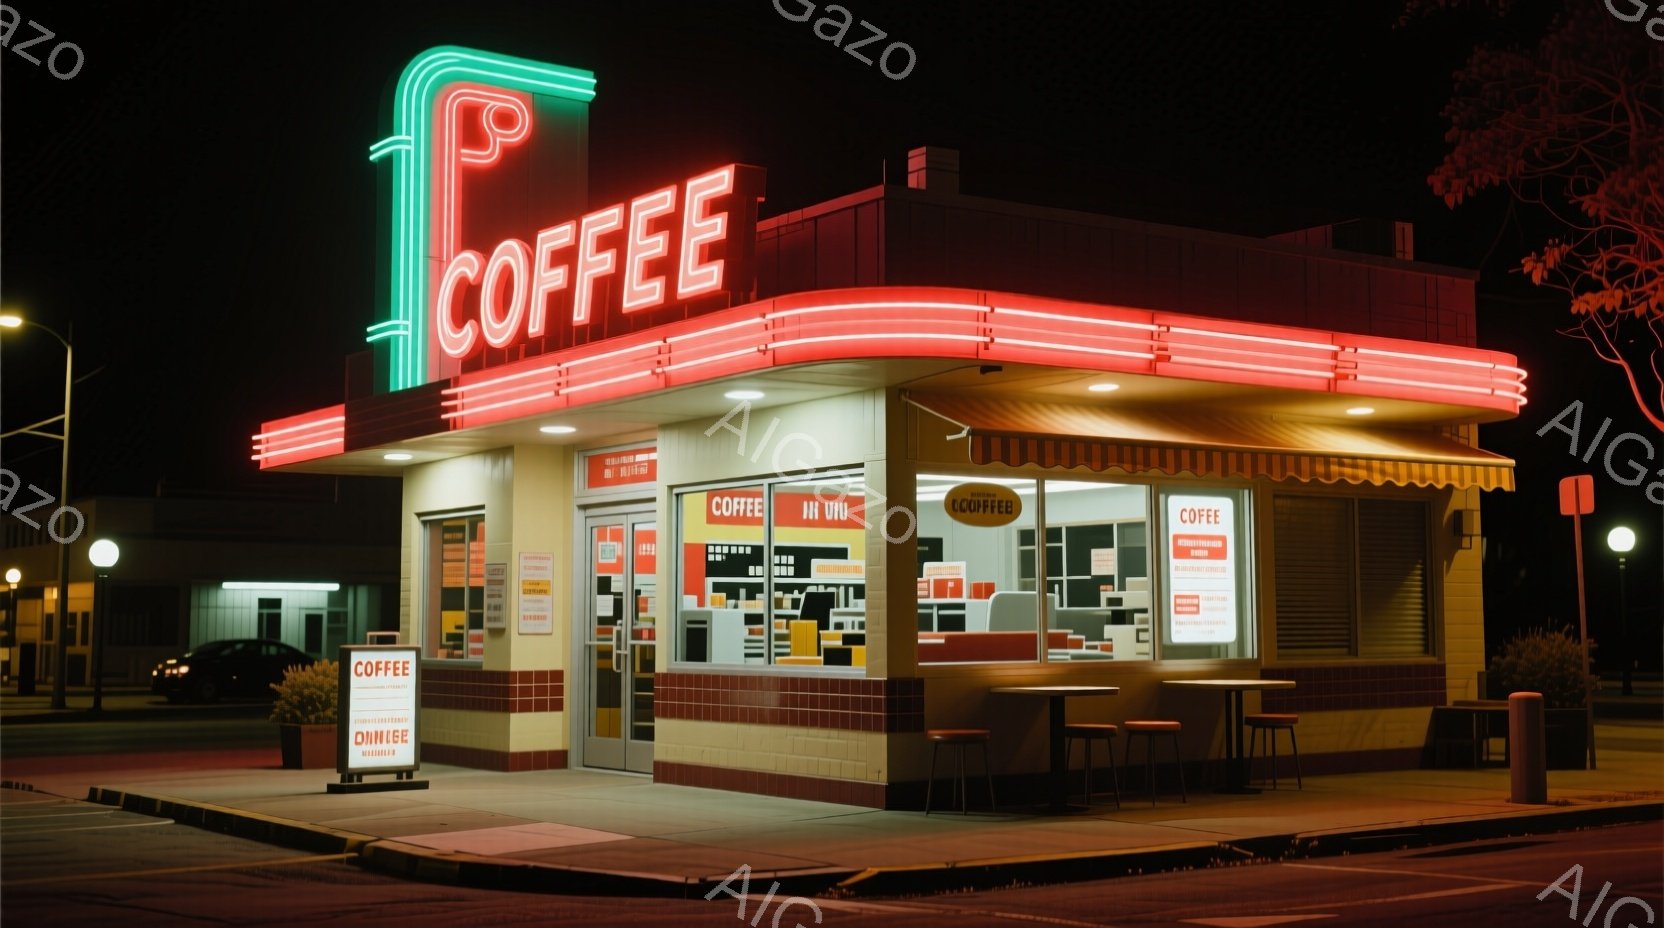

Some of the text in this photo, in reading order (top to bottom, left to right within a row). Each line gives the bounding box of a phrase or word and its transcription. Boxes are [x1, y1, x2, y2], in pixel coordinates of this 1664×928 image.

[437, 164, 735, 359] COFFEE
[711, 496, 763, 518] COFFEE
[1179, 507, 1220, 525] COFEE
[354, 660, 410, 678] COFFEE
